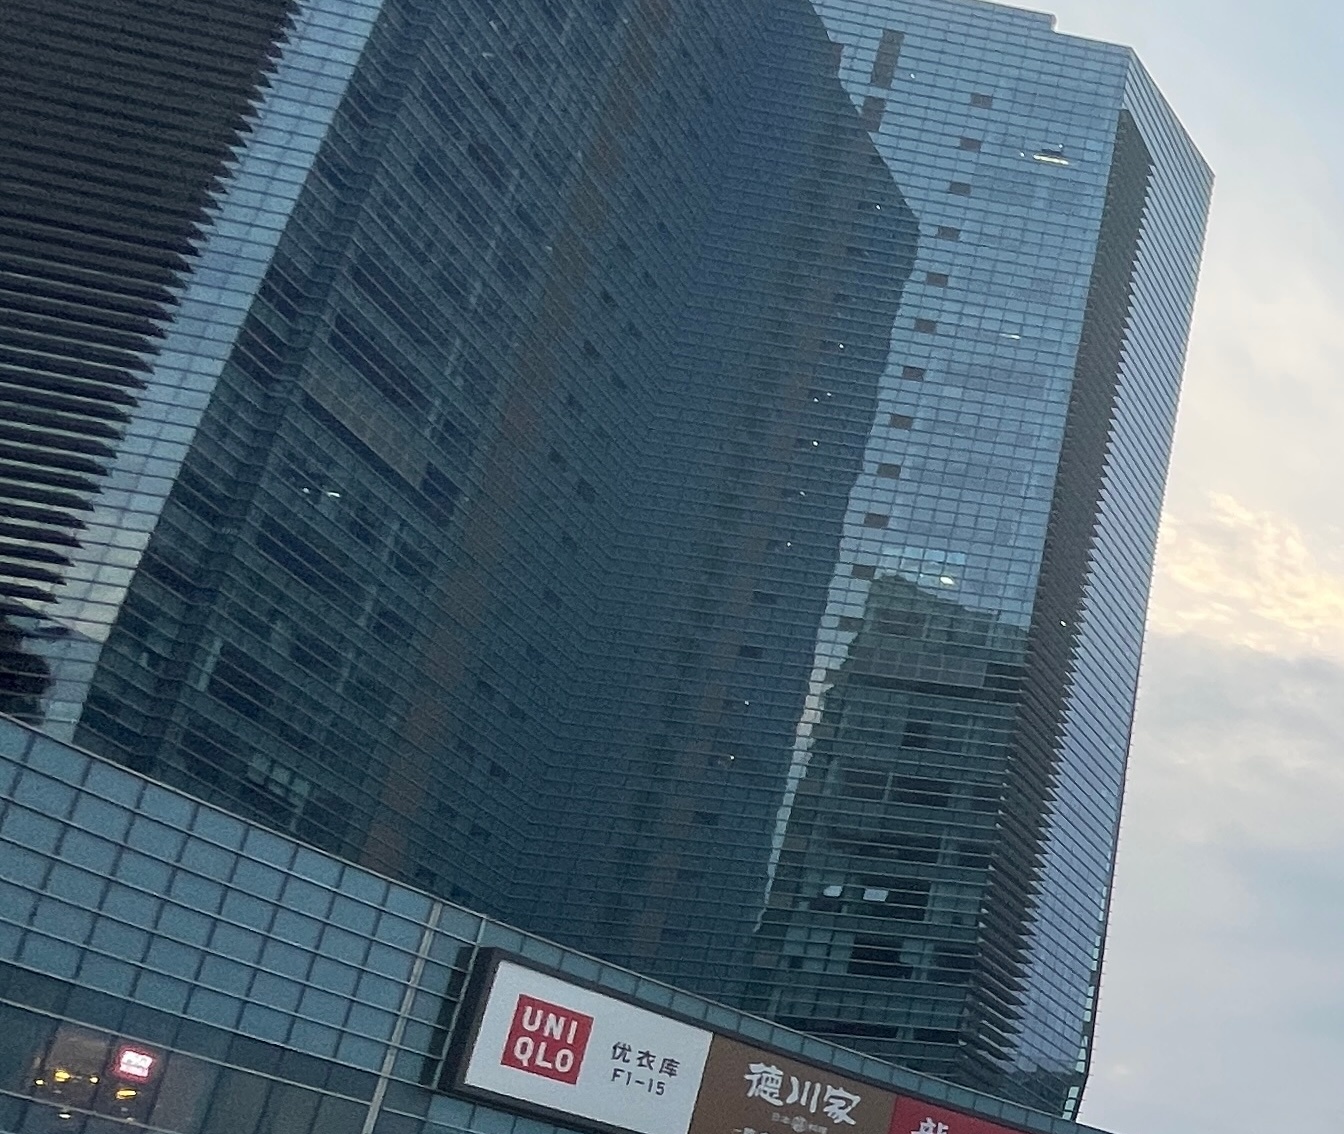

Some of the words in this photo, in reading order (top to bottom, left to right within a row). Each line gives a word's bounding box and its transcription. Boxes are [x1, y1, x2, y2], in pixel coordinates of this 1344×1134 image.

[521, 1005, 578, 1045] UNI
[513, 1036, 575, 1074] QLO
[609, 1040, 681, 1079] 优衣库
[611, 1068, 666, 1097] F1-15
[743, 1062, 862, 1126] 德川家
